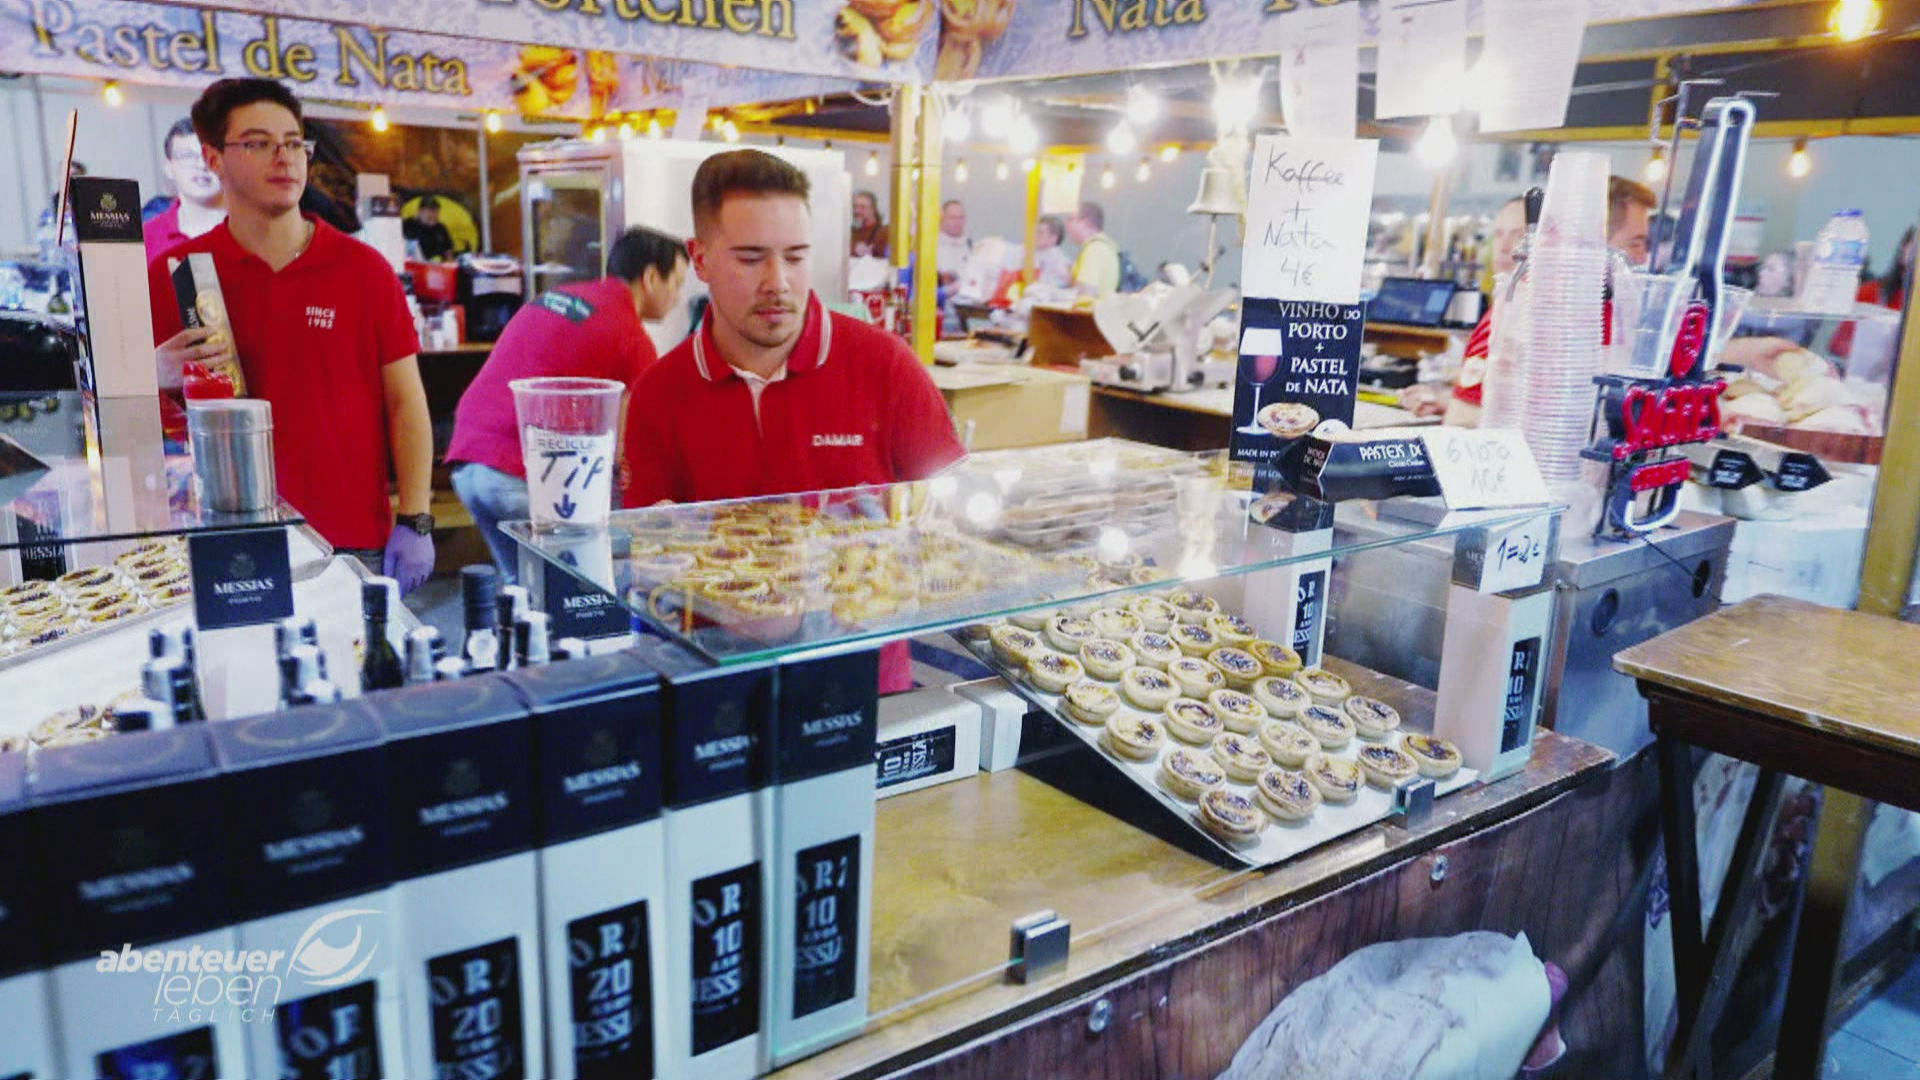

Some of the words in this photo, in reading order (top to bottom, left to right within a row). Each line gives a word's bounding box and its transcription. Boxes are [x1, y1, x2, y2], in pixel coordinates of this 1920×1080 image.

[28, 0, 224, 75] Pastel
[243, 16, 316, 81] de
[334, 26, 474, 96] Nata
[1265, 144, 1345, 194] Kaffee
[1263, 219, 1338, 250] Nata
[1279, 302, 1340, 319] VINHO
[1287, 322, 1348, 341] PORTO
[1290, 356, 1349, 376] PASTEL
[1285, 381, 1301, 393] DE
[1303, 378, 1350, 396] NATA
[213, 577, 275, 596] MESSIAS
[803, 896, 837, 930] 10
[713, 920, 743, 958] 10
[588, 958, 634, 1001] 20
